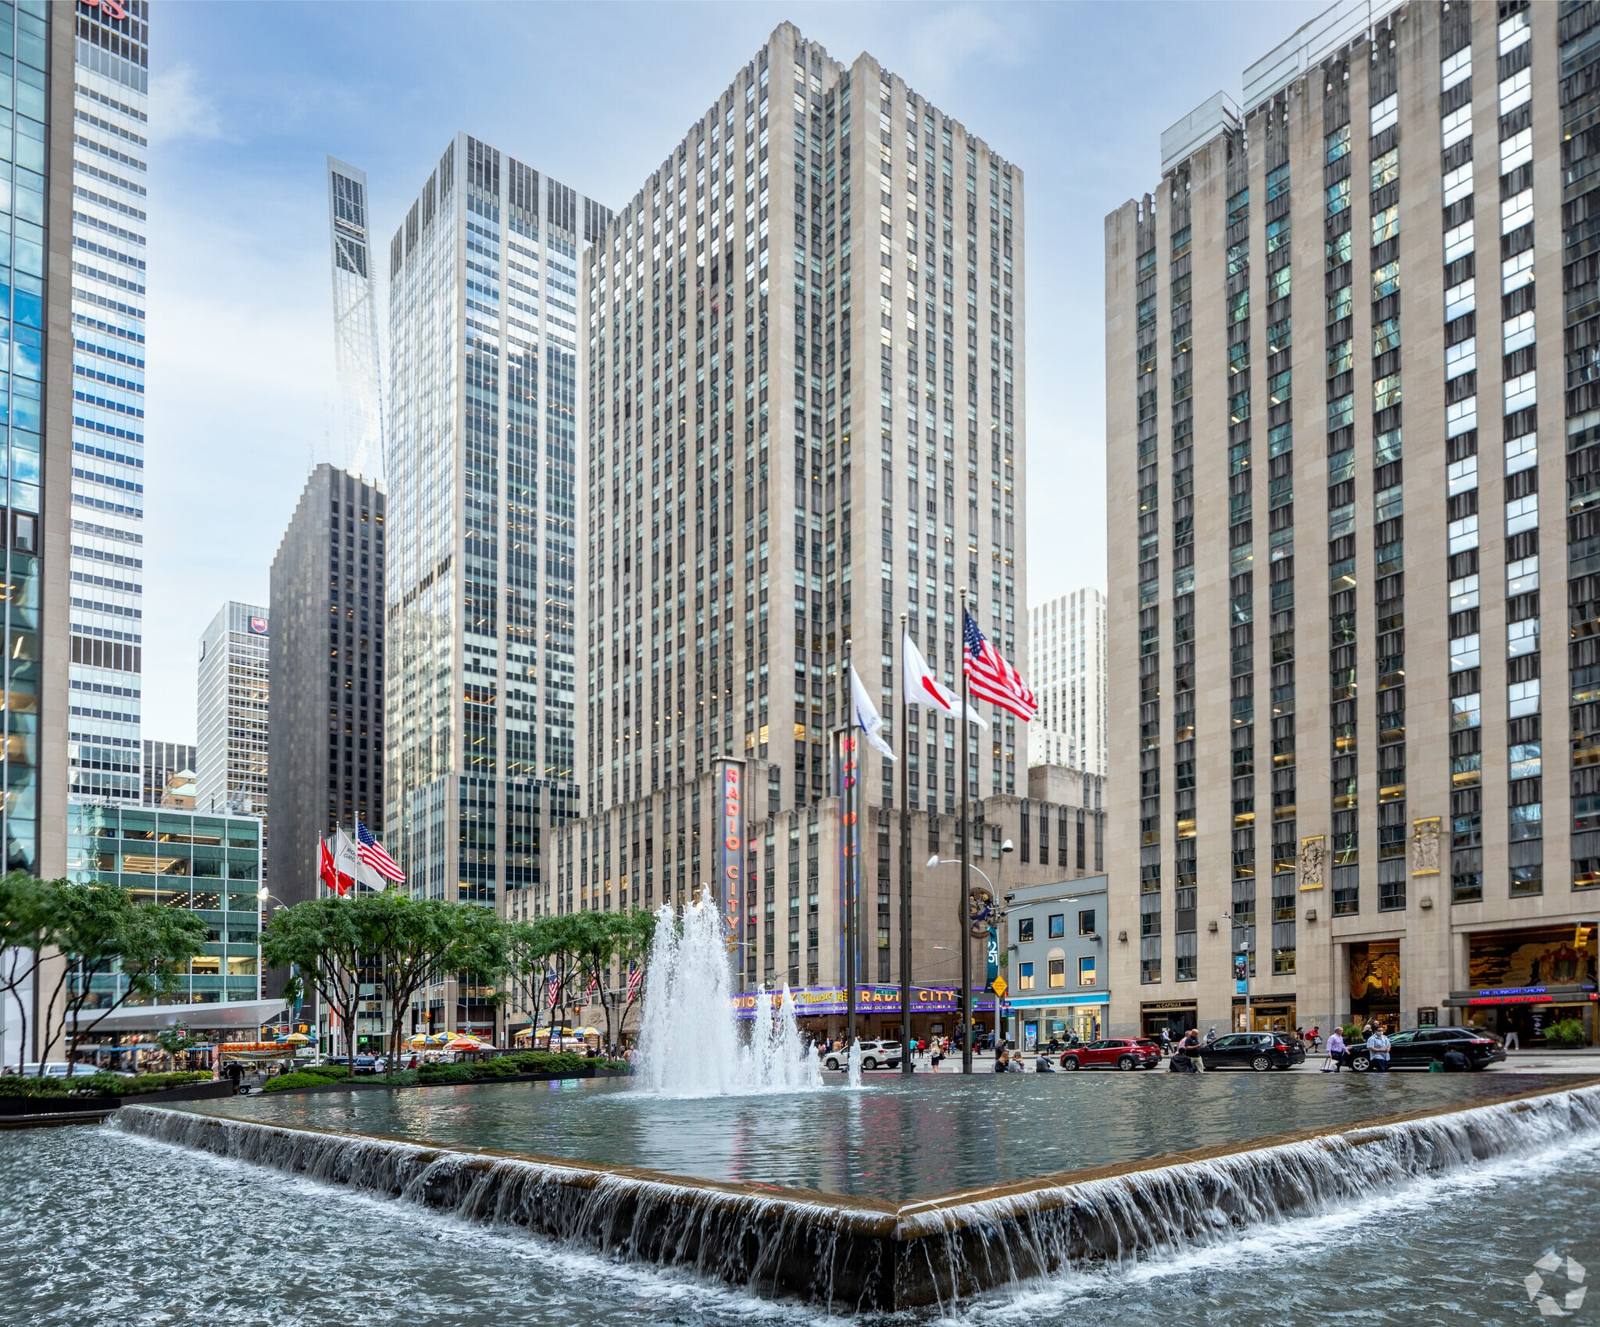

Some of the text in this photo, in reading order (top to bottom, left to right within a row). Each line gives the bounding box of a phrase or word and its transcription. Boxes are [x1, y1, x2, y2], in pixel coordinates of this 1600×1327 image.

[725, 768, 741, 851] RADIO
[843, 737, 857, 827] RADO
[726, 865, 740, 930] CITY
[861, 990, 901, 1003] RADI
[919, 990, 955, 1003] CITY
